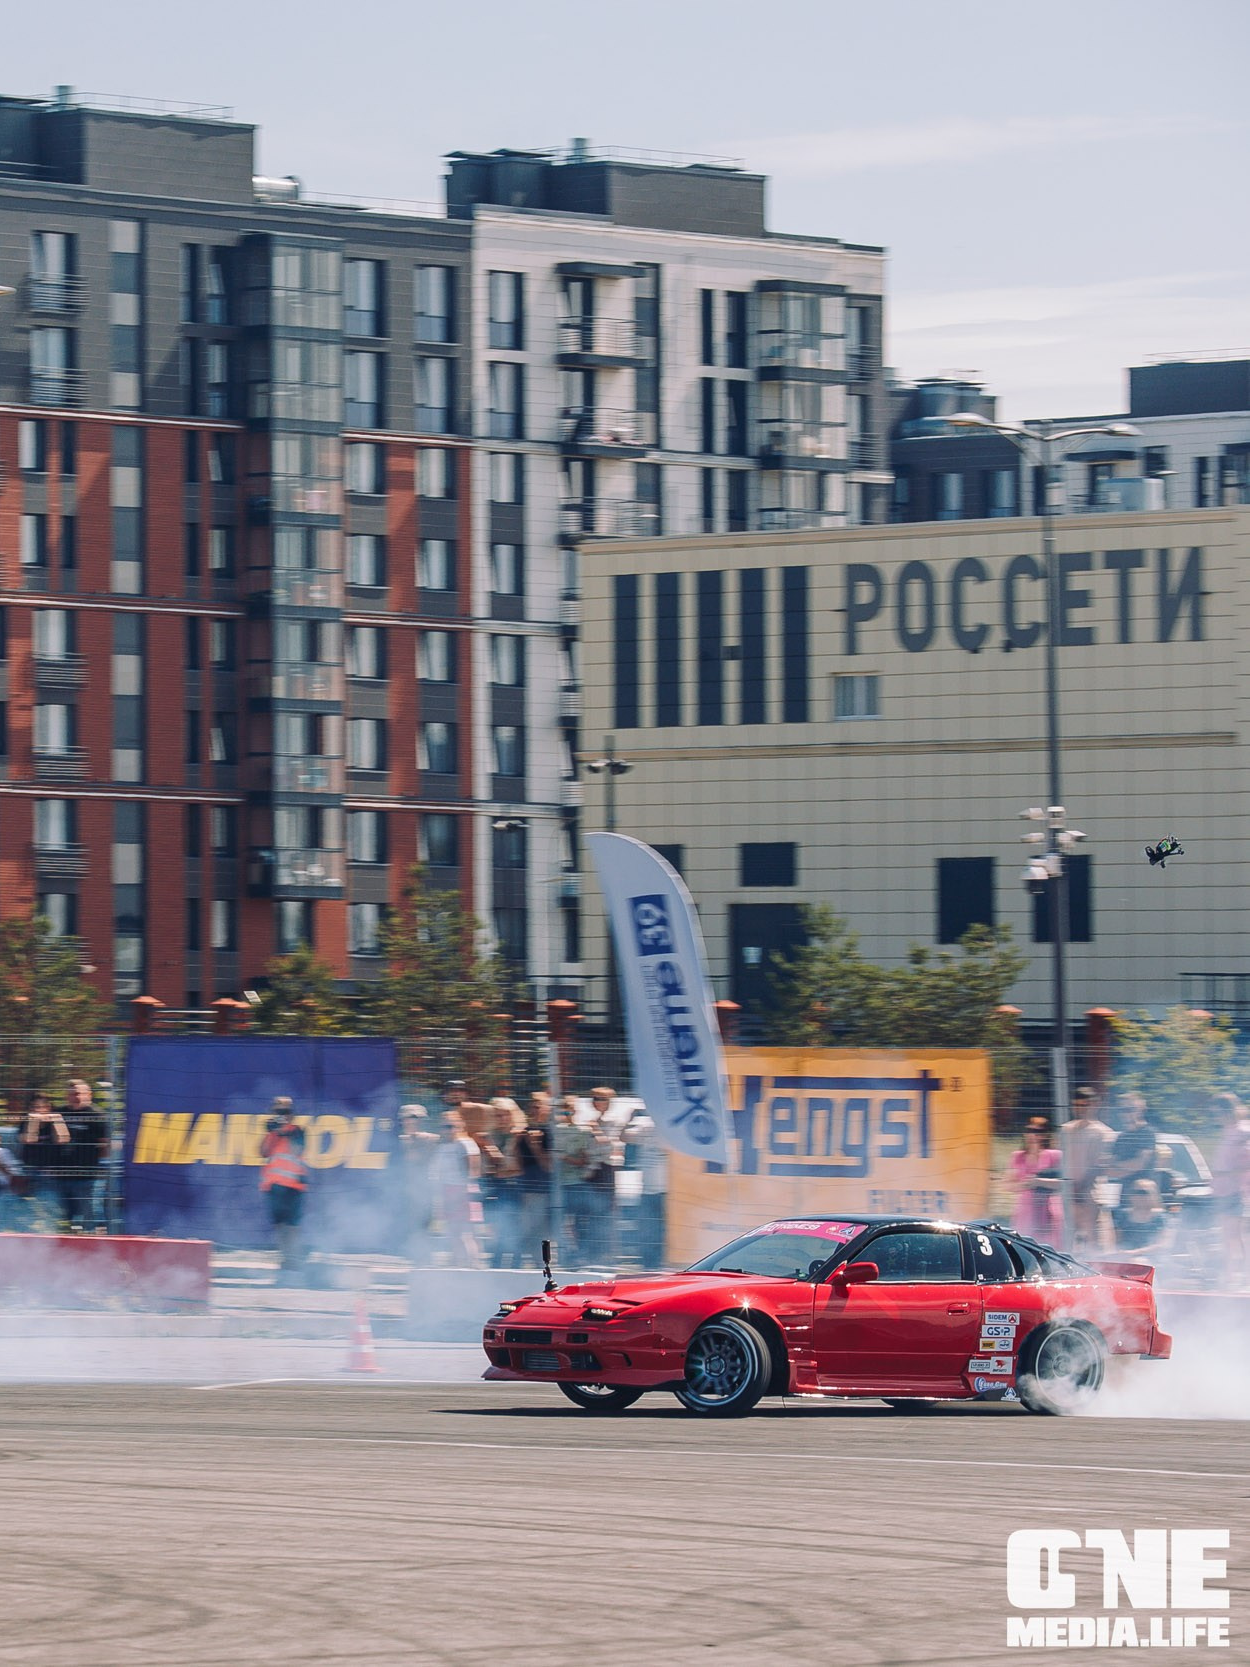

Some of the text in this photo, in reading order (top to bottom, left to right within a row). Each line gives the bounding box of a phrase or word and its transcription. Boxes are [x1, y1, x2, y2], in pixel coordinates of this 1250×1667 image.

[845, 546, 1205, 656] РОССЕТИ
[132, 1112, 391, 1169] MANOL
[977, 1234, 993, 1256] 3
